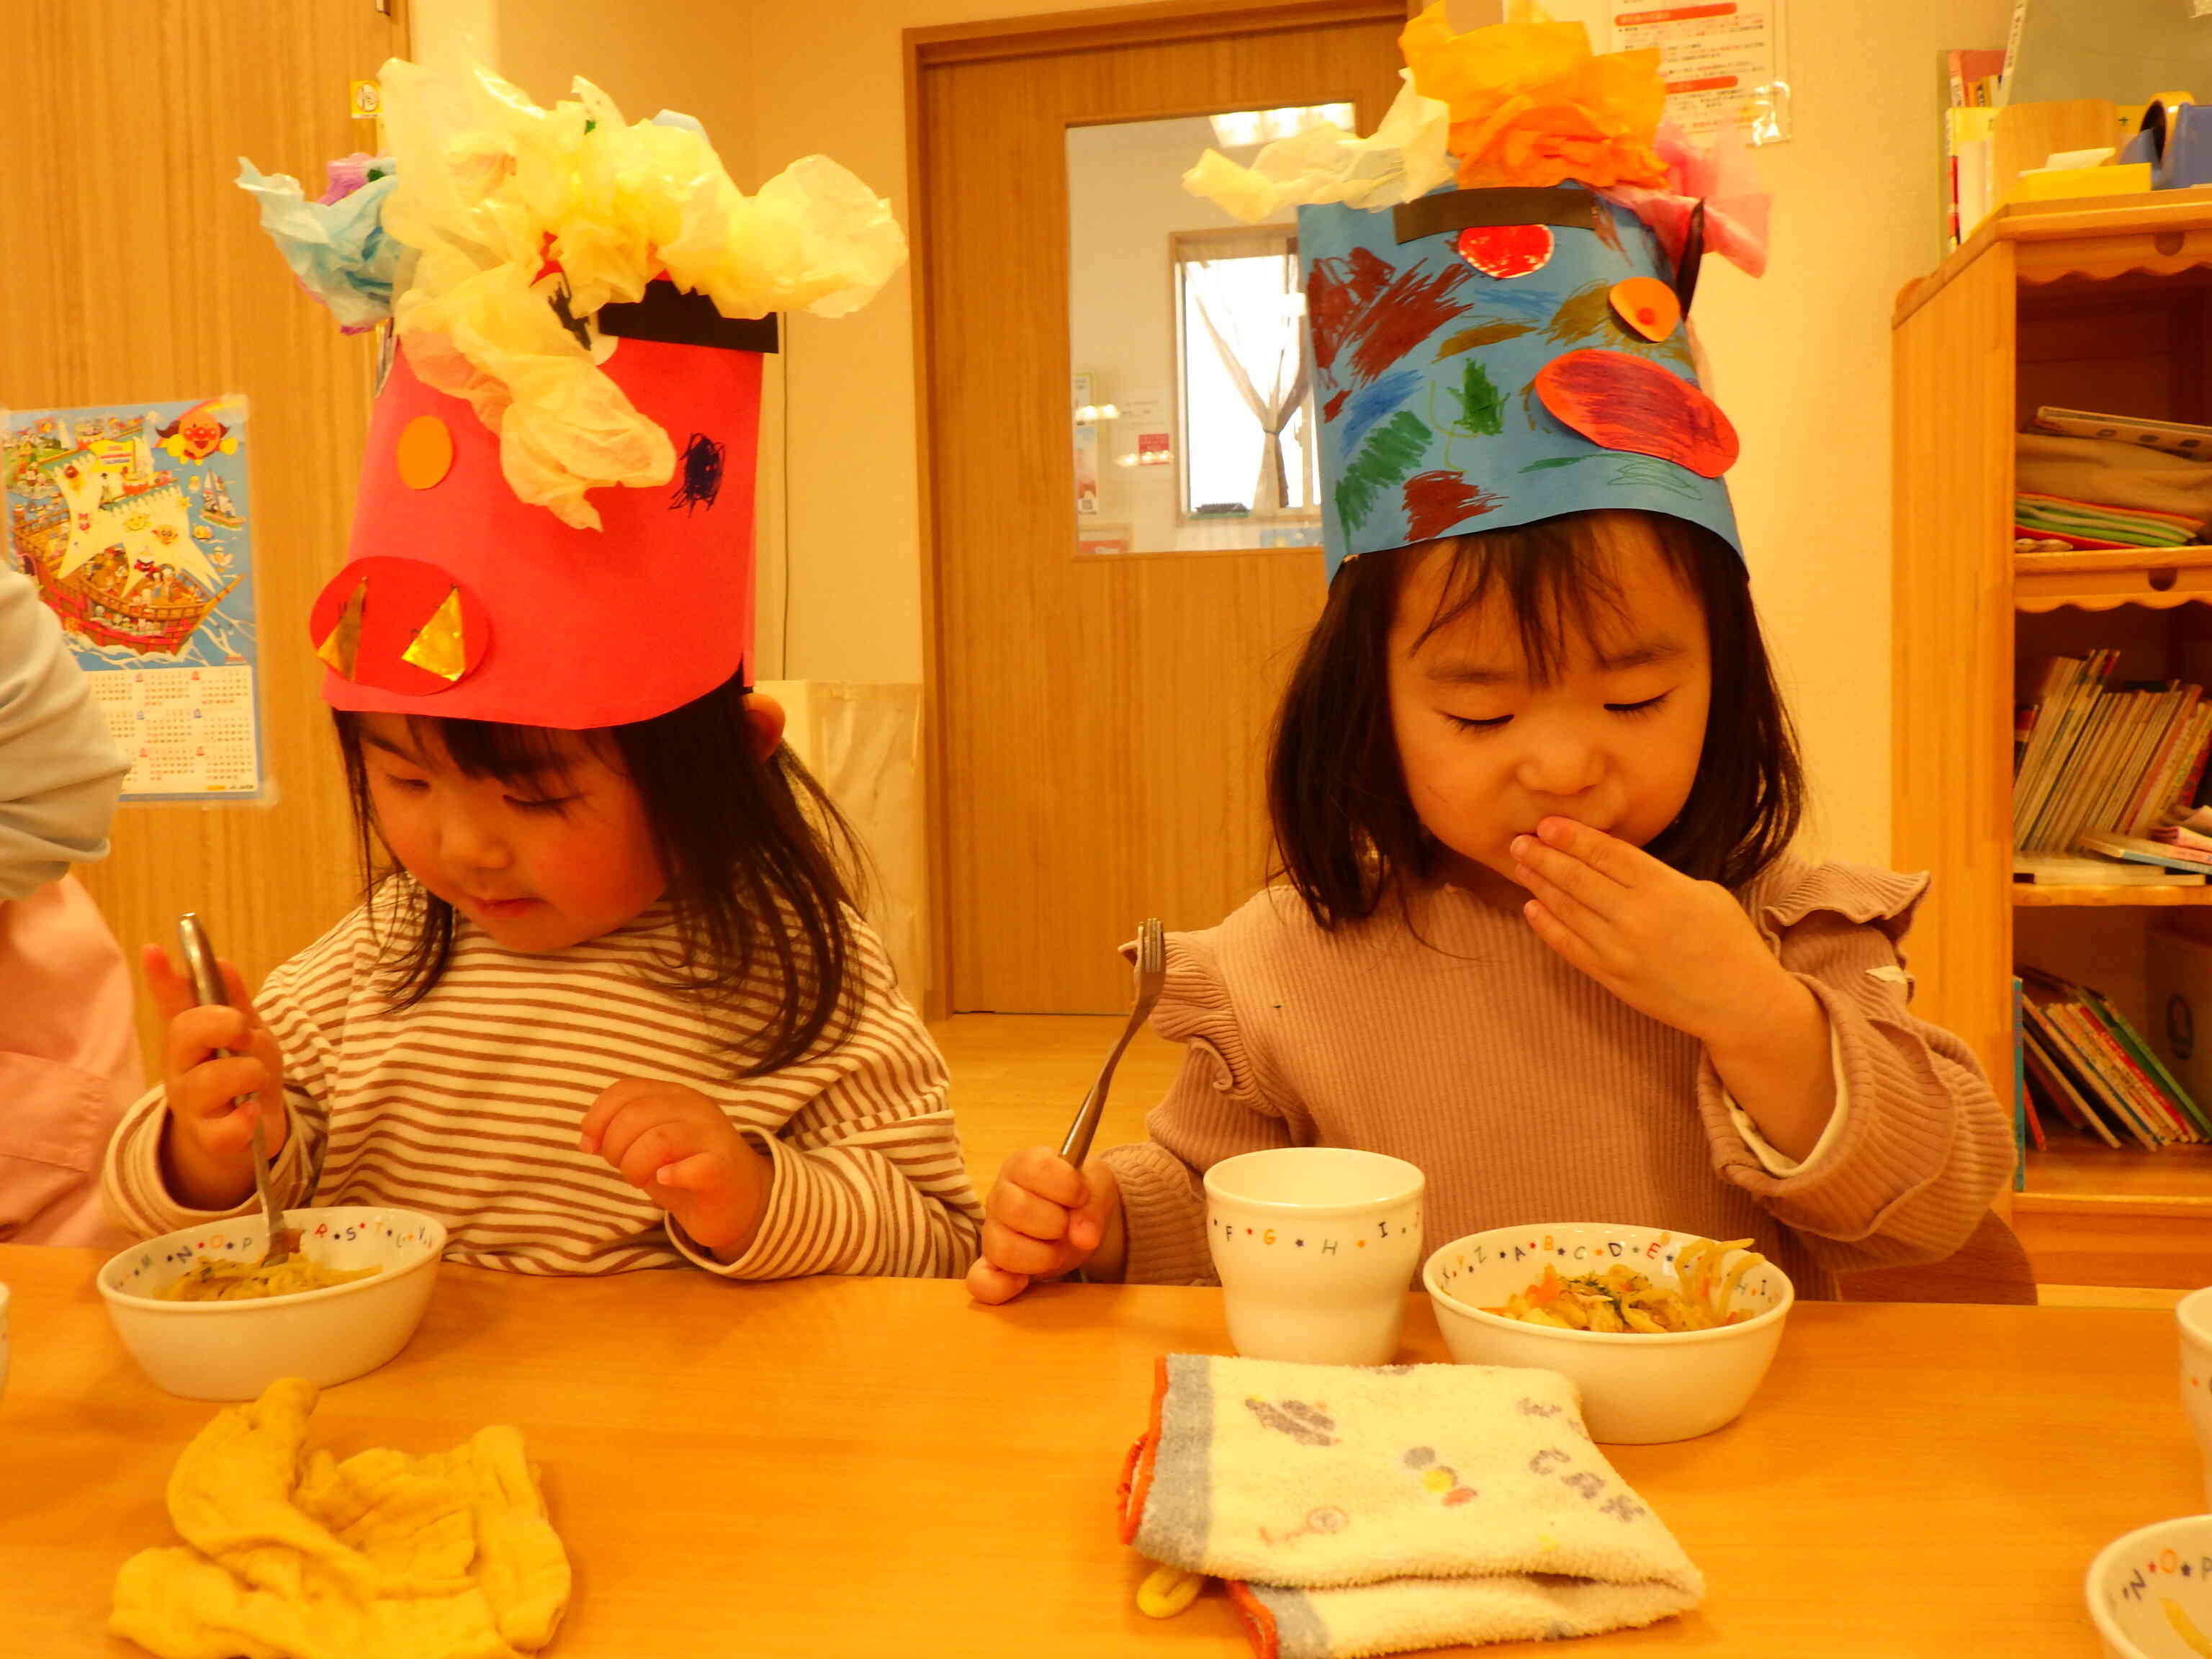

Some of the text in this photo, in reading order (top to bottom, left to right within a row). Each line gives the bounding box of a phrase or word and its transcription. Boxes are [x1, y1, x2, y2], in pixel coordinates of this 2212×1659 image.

[176, 1245, 193, 1264] N
[242, 1237, 252, 1250] P
[346, 1227, 357, 1241] S
[1226, 1221, 1389, 1256] F G H I
[1474, 1246, 1487, 1264] Z
[1514, 1246, 1527, 1261] A
[1543, 1235, 1555, 1251] B
[1574, 1246, 1586, 1260] C
[1608, 1243, 1623, 1257] D
[1647, 1242, 1660, 1259] E
[2128, 1568, 2146, 1600] N
[2160, 1549, 2177, 1573] O
